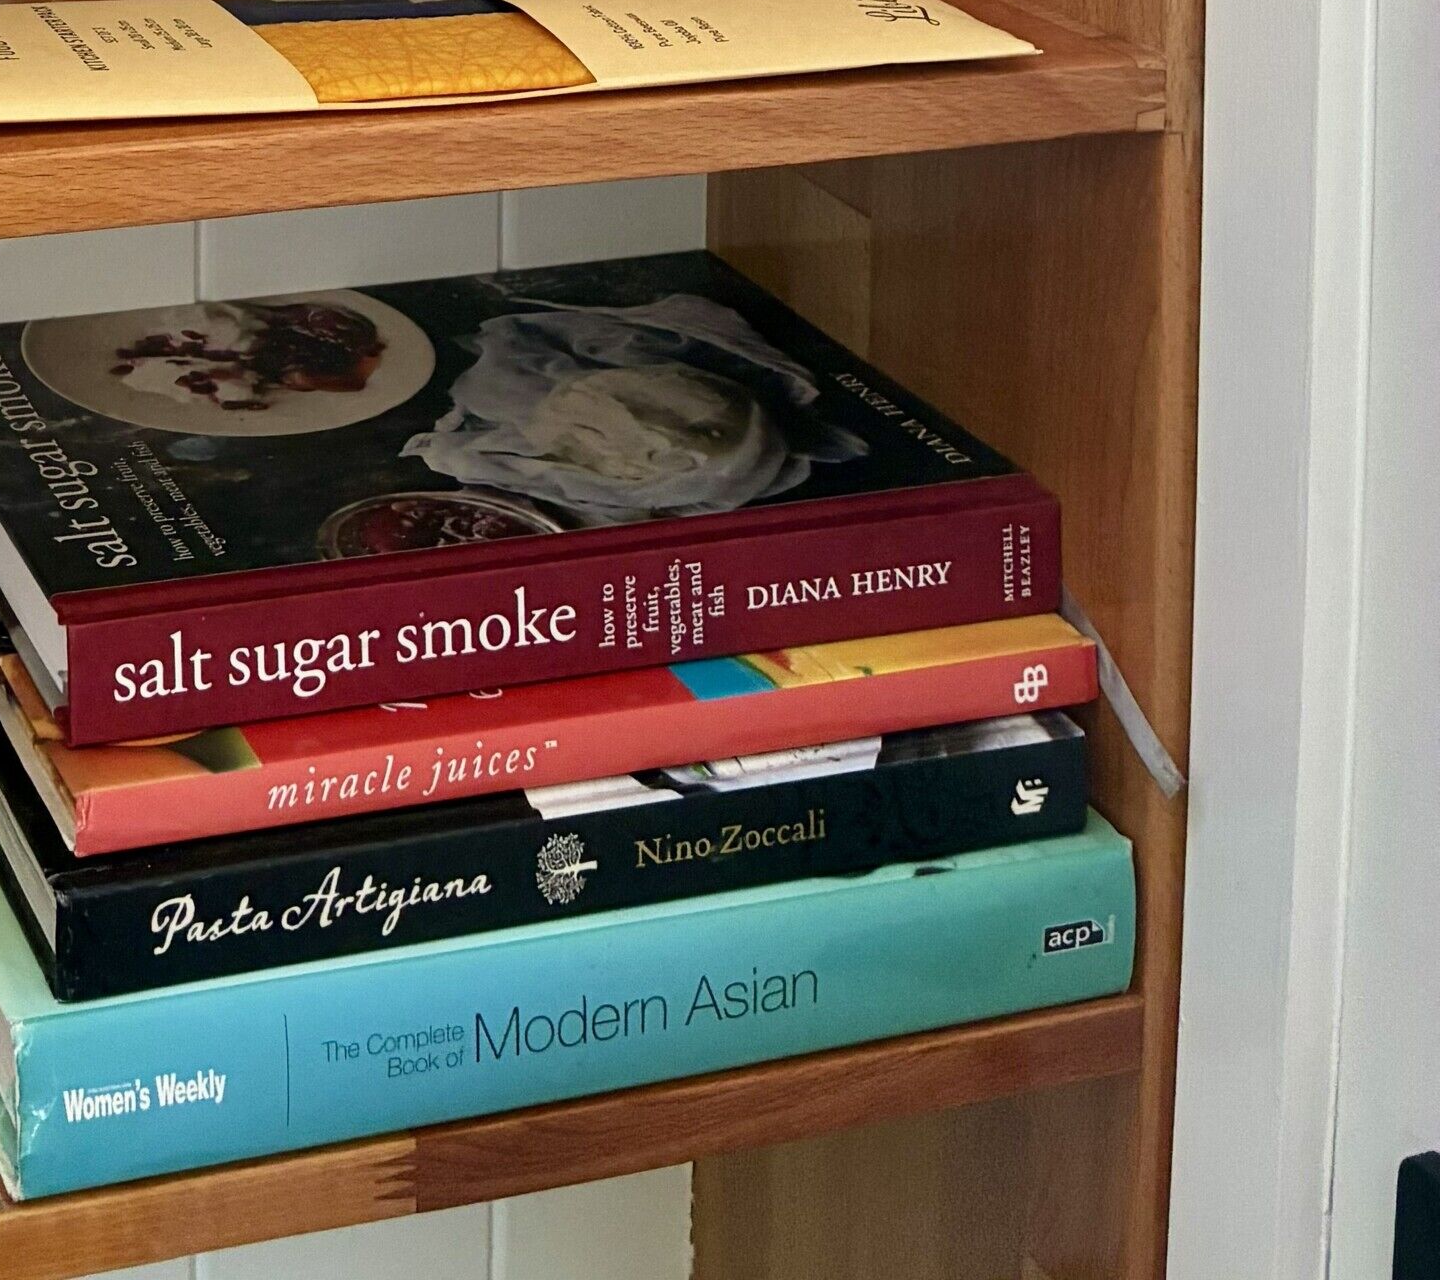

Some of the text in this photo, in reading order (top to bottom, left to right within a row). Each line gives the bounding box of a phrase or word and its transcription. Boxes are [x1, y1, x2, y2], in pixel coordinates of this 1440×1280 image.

[43, 17, 83, 43] STARTER
[68, 43, 109, 71] KITCHEN
[19, 438, 100, 511] sugar
[157, 475, 186, 502] meat
[130, 481, 175, 523] preserve
[53, 515, 137, 568] salt
[167, 537, 195, 561] how
[1002, 523, 1015, 602] MITCHELL
[1020, 524, 1032, 597] BEAZLEY
[625, 575, 643, 649] preserve
[642, 586, 661, 632] fruit,
[663, 558, 683, 655] vegetables,
[686, 561, 703, 645] meat and
[707, 584, 725, 617] fish
[747, 561, 952, 610] DIANA HENRY
[599, 583, 615, 647] how to
[113, 587, 577, 702] salt sugar smoke
[268, 756, 412, 810] miracle
[635, 809, 827, 869] Nino Zoccali
[151, 867, 492, 955] Pasta Artigiana
[1048, 926, 1091, 949] acp
[474, 967, 818, 1063] Modern Asian
[321, 1023, 465, 1063] The Complete
[388, 1048, 465, 1079] Book of
[63, 1068, 227, 1123] Women's Weekly
